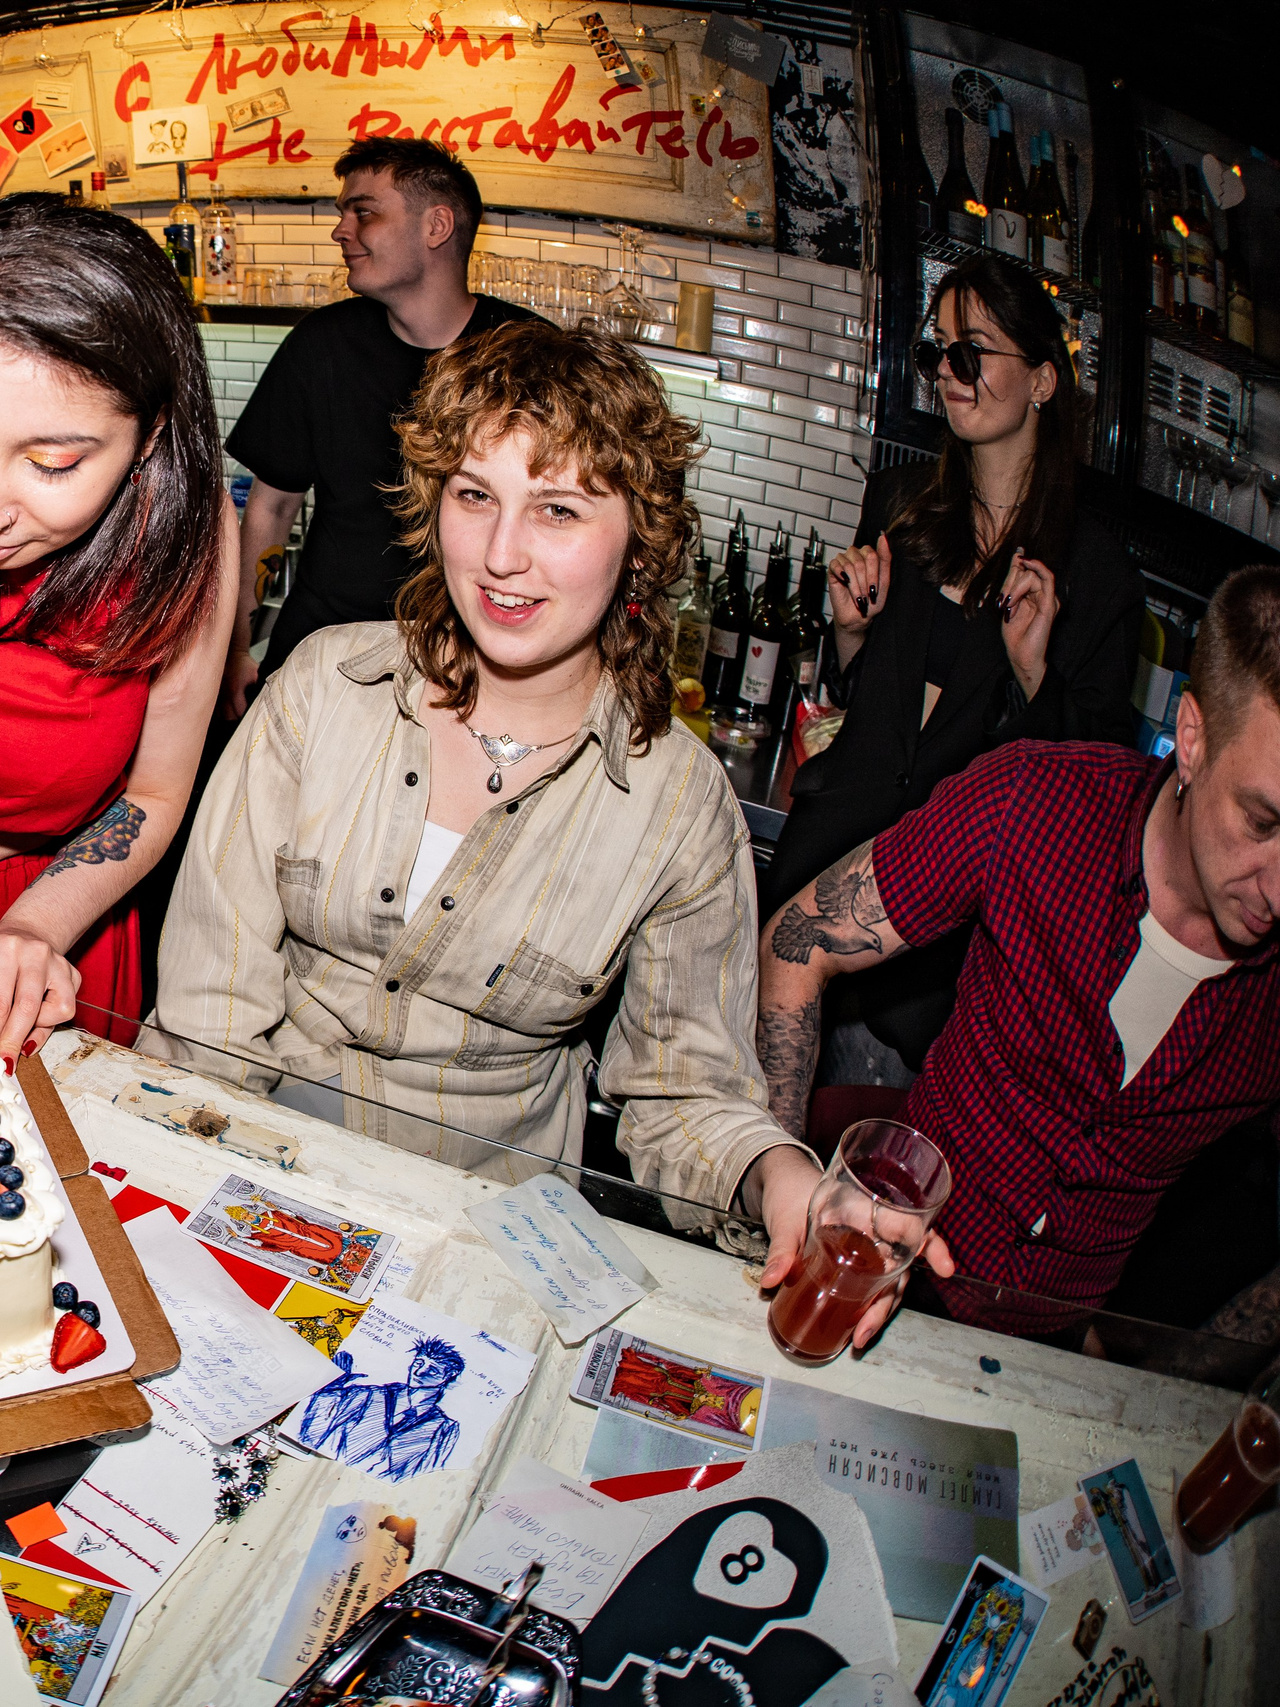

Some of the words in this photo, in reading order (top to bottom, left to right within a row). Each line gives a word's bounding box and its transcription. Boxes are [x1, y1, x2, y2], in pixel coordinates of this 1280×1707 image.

[827, 1437, 859, 1454] нет
[868, 1448, 898, 1463] уже
[825, 1453, 930, 1494] МОВСИСЯН
[908, 1457, 955, 1474] здесь
[938, 1479, 1003, 1508] ГАМЛЕТ
[720, 1544, 764, 1585] 8
[324, 1587, 356, 1635] АЛКОГОЛЮ
